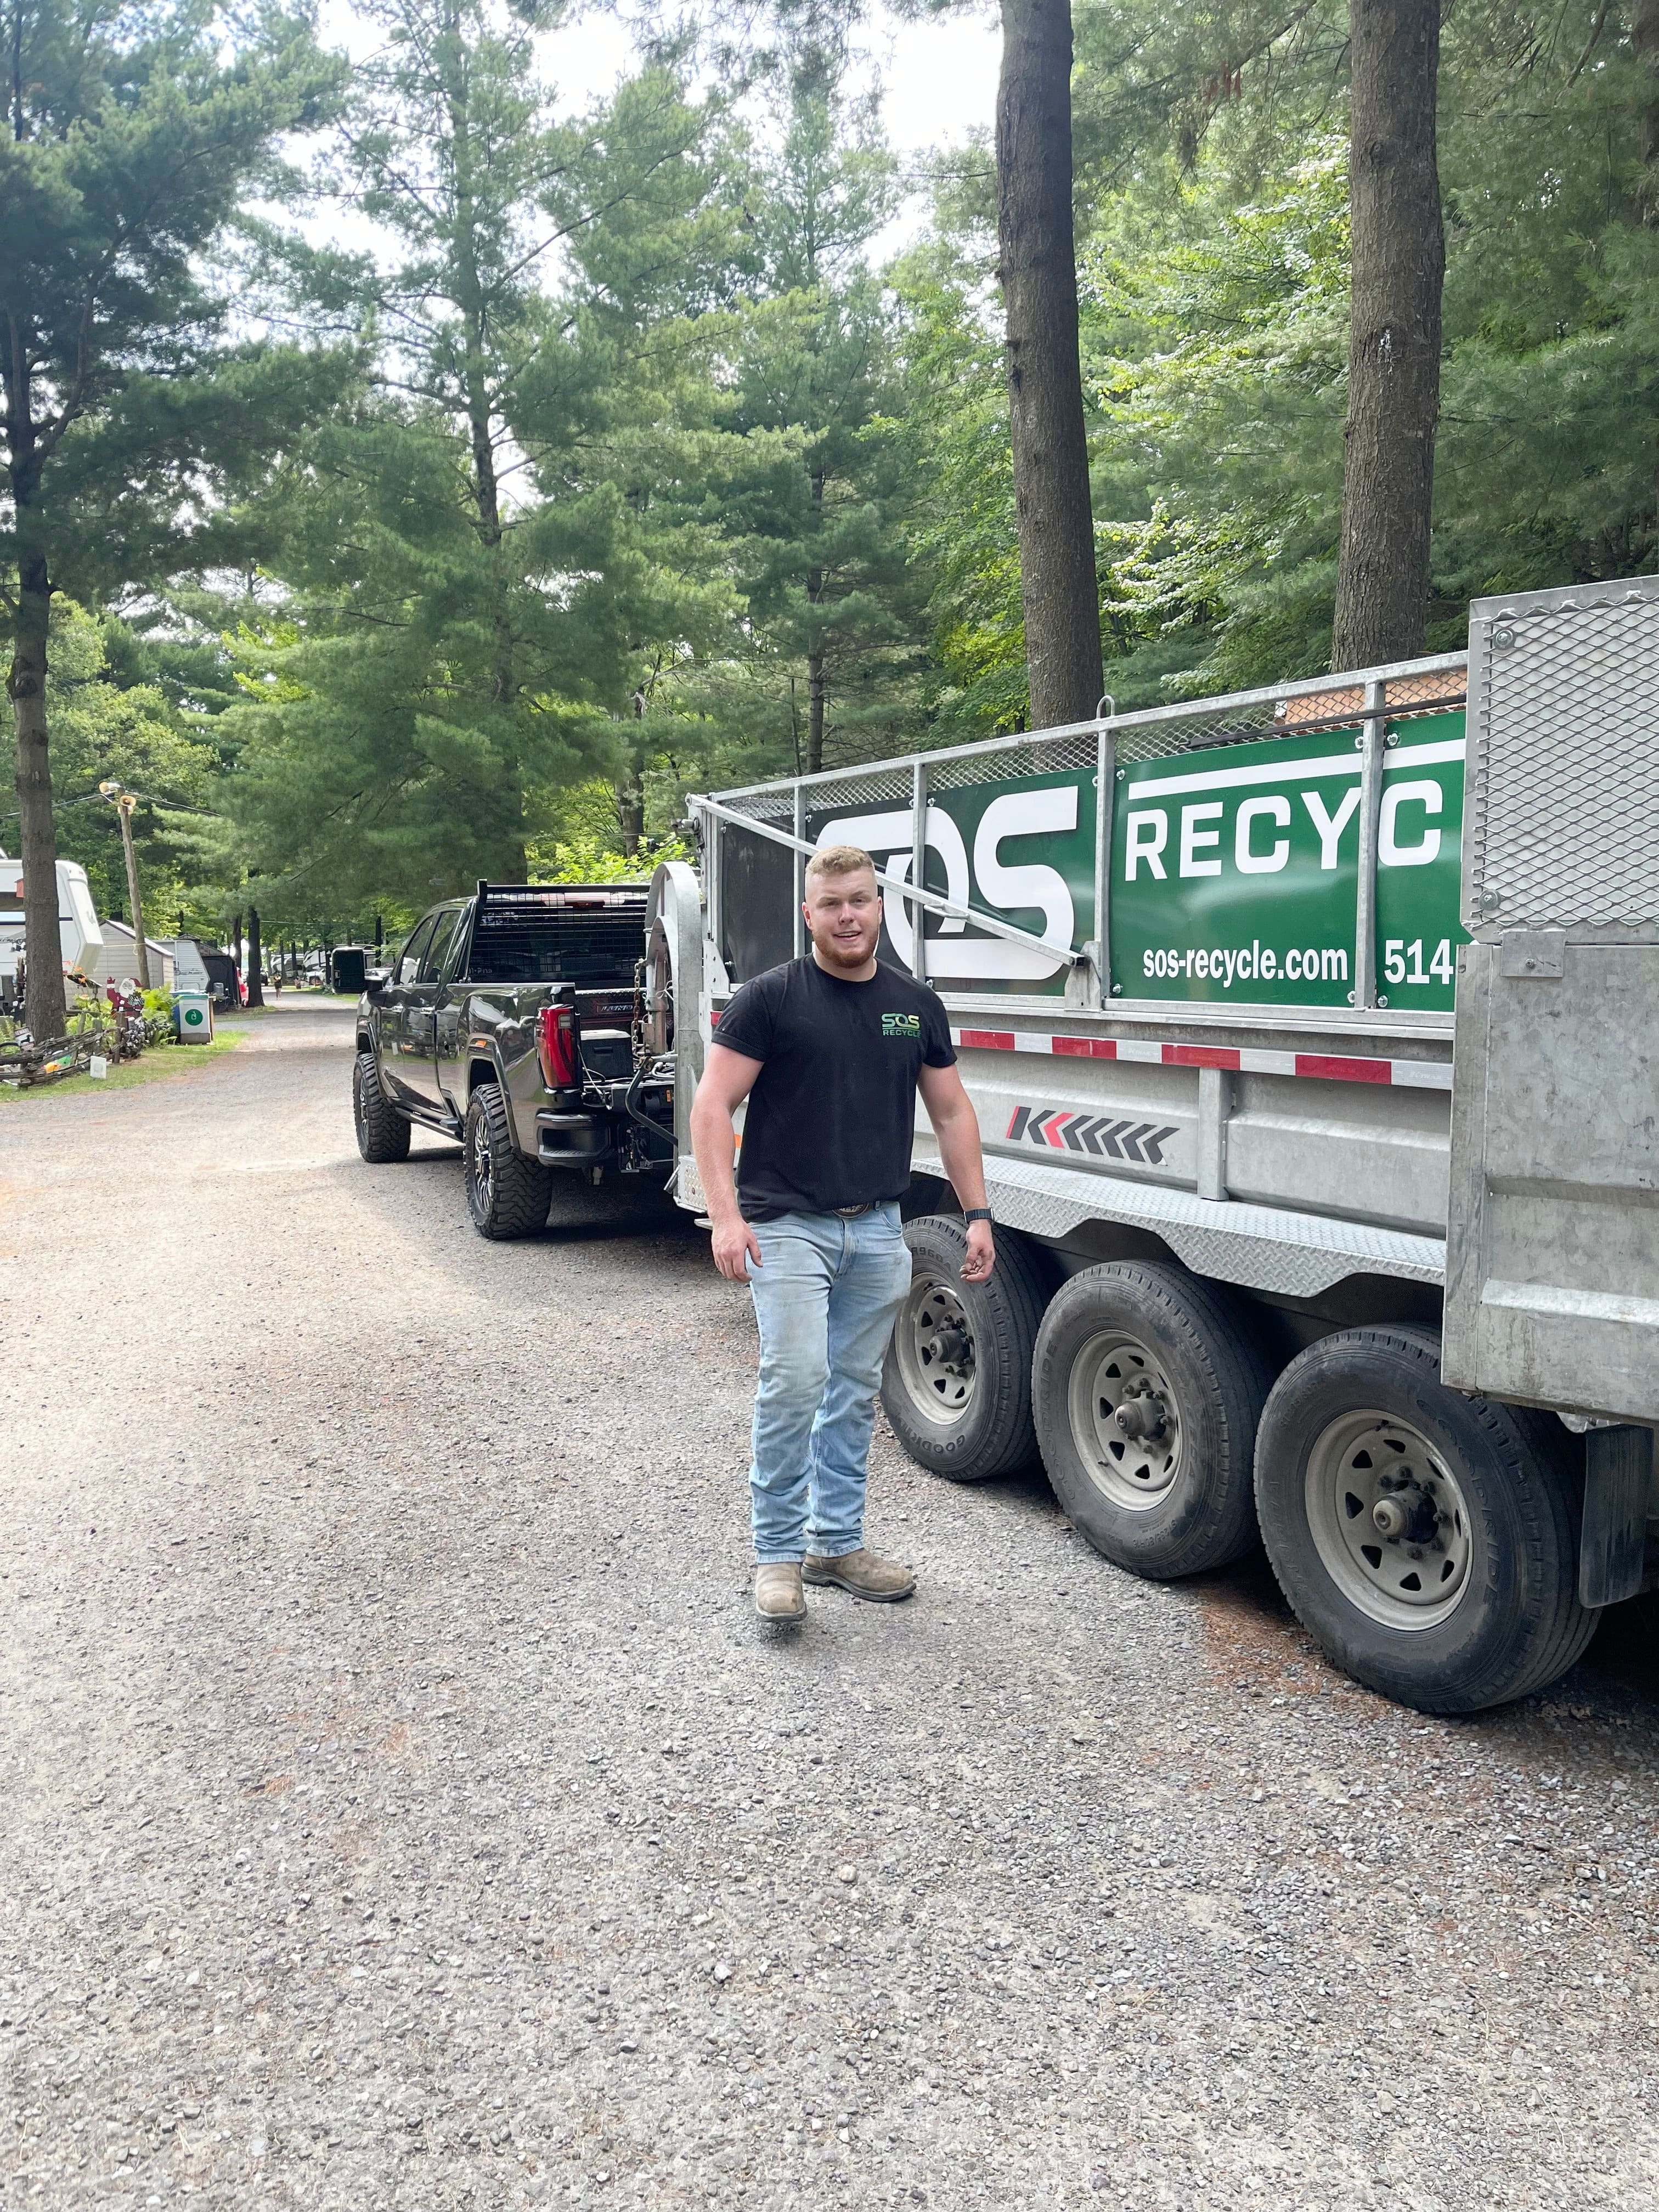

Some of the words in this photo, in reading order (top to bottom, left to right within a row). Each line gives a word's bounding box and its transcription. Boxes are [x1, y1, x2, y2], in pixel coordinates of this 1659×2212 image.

[1125, 779, 1464, 882] RECYC
[1143, 939, 1348, 988] sos-recycle.com
[881, 1013, 920, 1029] SOS
[883, 1029, 922, 1039] RECYCLE
